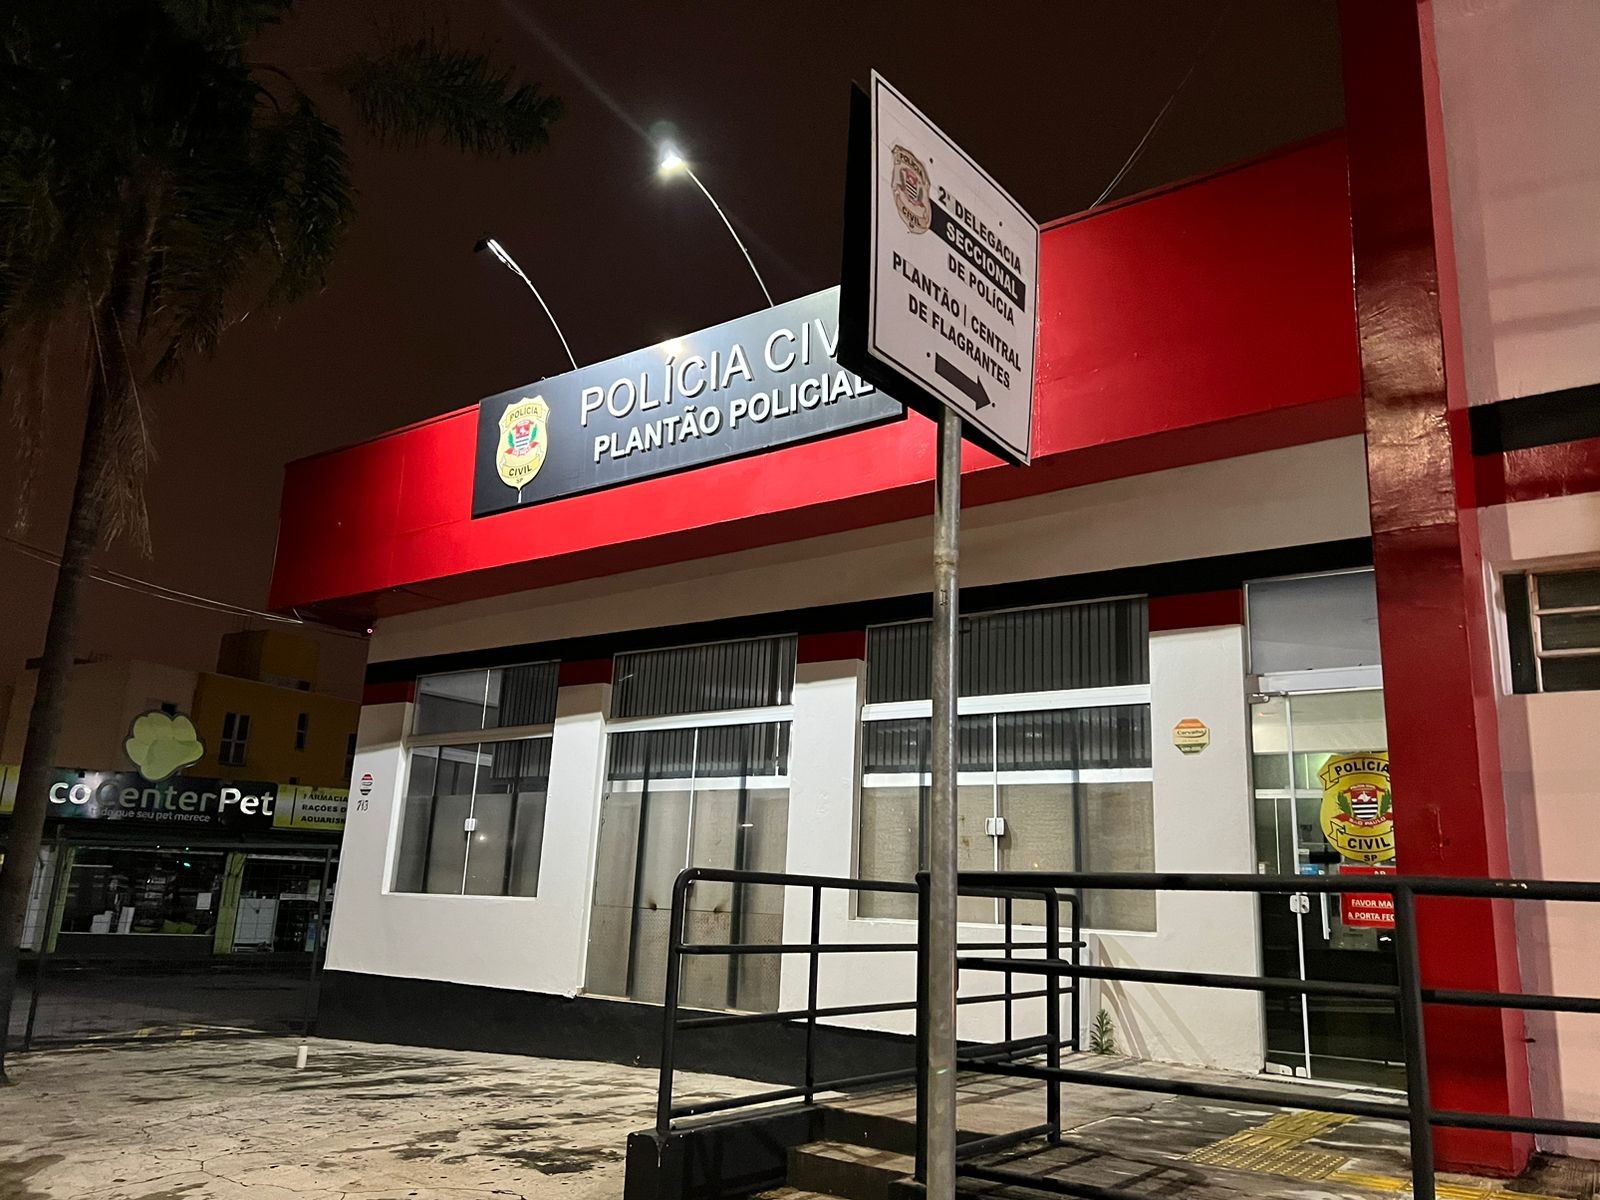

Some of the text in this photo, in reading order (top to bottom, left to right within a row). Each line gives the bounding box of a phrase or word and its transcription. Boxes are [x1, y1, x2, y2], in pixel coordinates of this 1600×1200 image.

[955, 199, 1021, 275] DELEGACIA
[946, 221, 1019, 300] SECCIONAL
[948, 252, 1015, 327] DE POLÍCIA
[892, 250, 960, 318] PLANTÃO
[971, 315, 1022, 373] CENTRAL
[908, 293, 1011, 390] DE FLAGRANTES
[580, 343, 752, 427] POLÍCIA
[593, 369, 875, 463] PLANTÃO POLICIAL
[508, 466, 533, 477] CIVIL
[1334, 757, 1390, 776] POLÍCIA
[136, 809, 155, 819] seu
[155, 810, 174, 822] pet
[174, 812, 212, 823] merece
[302, 803, 338, 812] RAÇÕES
[1347, 837, 1391, 850] CIVIL
[1363, 854, 1378, 862] SP
[1351, 898, 1377, 908] FAVOR
[1348, 911, 1354, 920] A
[1354, 911, 1381, 921] PORTA
